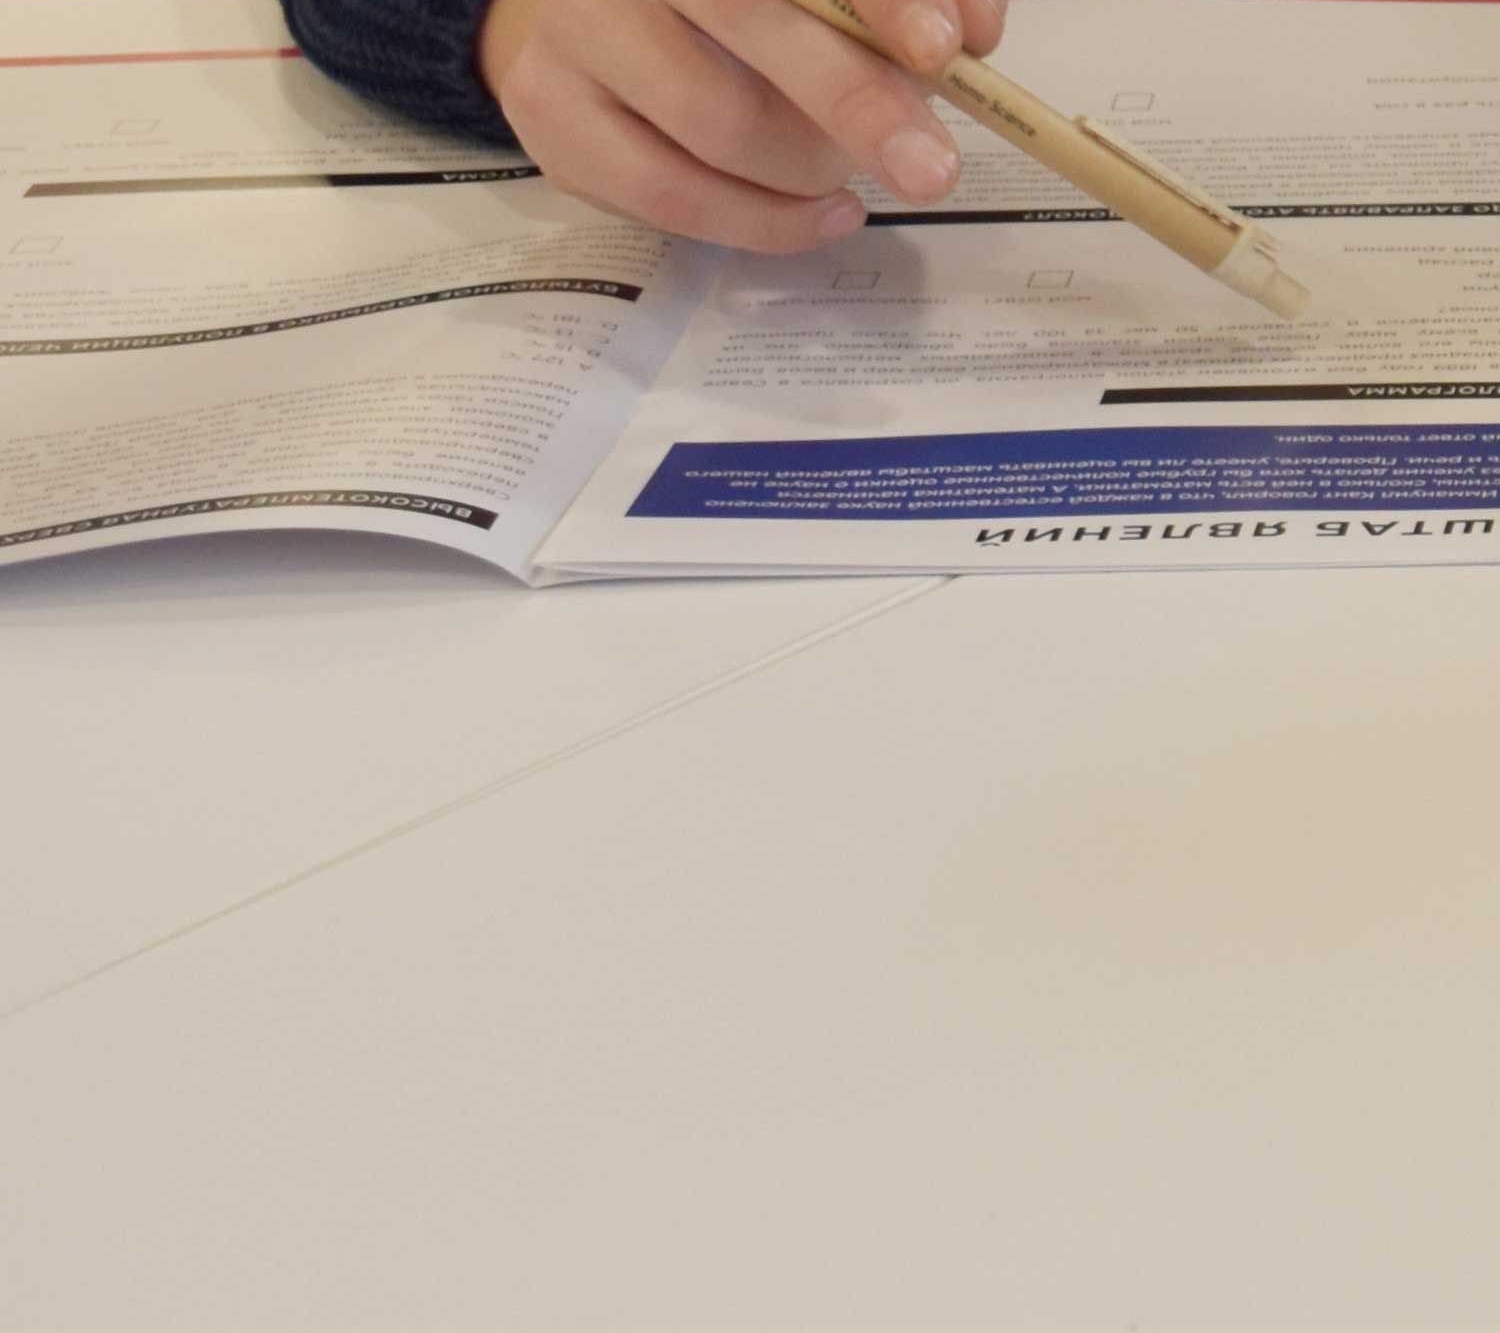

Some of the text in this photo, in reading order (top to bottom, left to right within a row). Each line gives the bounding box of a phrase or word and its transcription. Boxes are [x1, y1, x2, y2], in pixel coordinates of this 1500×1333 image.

[440, 169, 529, 180] АТОМА
[1228, 205, 1294, 215] АТО
[1301, 203, 1464, 214] ЗАПРАВЛЯТЬ
[435, 281, 620, 300] БУТЫЛОЧНОЕ
[275, 294, 430, 329] ГОРЛЫШКО
[250, 323, 270, 333] В
[70, 325, 246, 350] ПОПУЛЯЦИИ
[1272, 432, 1334, 441] один.
[997, 457, 1119, 469] оценивать
[1190, 455, 1270, 464] умеете
[1273, 454, 1398, 466] Проверьте,
[1403, 454, 1462, 463] речи.
[772, 467, 874, 479] явлений
[876, 462, 994, 476] масштабы
[1134, 468, 1217, 479] грубые
[1219, 469, 1253, 479] бы
[1309, 466, 1388, 475] делать
[1391, 465, 1476, 474] умения
[853, 475, 940, 486] оценки
[942, 470, 1131, 483] количественные
[762, 478, 831, 486] науке
[1072, 480, 1212, 491] математики.
[1269, 479, 1313, 488] ней
[1336, 478, 1427, 486] сколько
[775, 489, 909, 497] начинается
[912, 486, 1046, 496] математика
[1049, 485, 1068, 494] А
[1219, 489, 1318, 498] говорил,
[1379, 487, 1498, 499] Иммануил
[1066, 490, 1155, 505] каждой
[1322, 490, 1375, 500] Кант
[703, 499, 830, 508] заключено
[834, 499, 903, 508] науке
[905, 496, 1064, 510] естественной
[99, 493, 473, 526] ВЫСОКОТЕМПЕРАТУРНАЯ
[974, 520, 1288, 546] ЯВЛЕНИЙ
